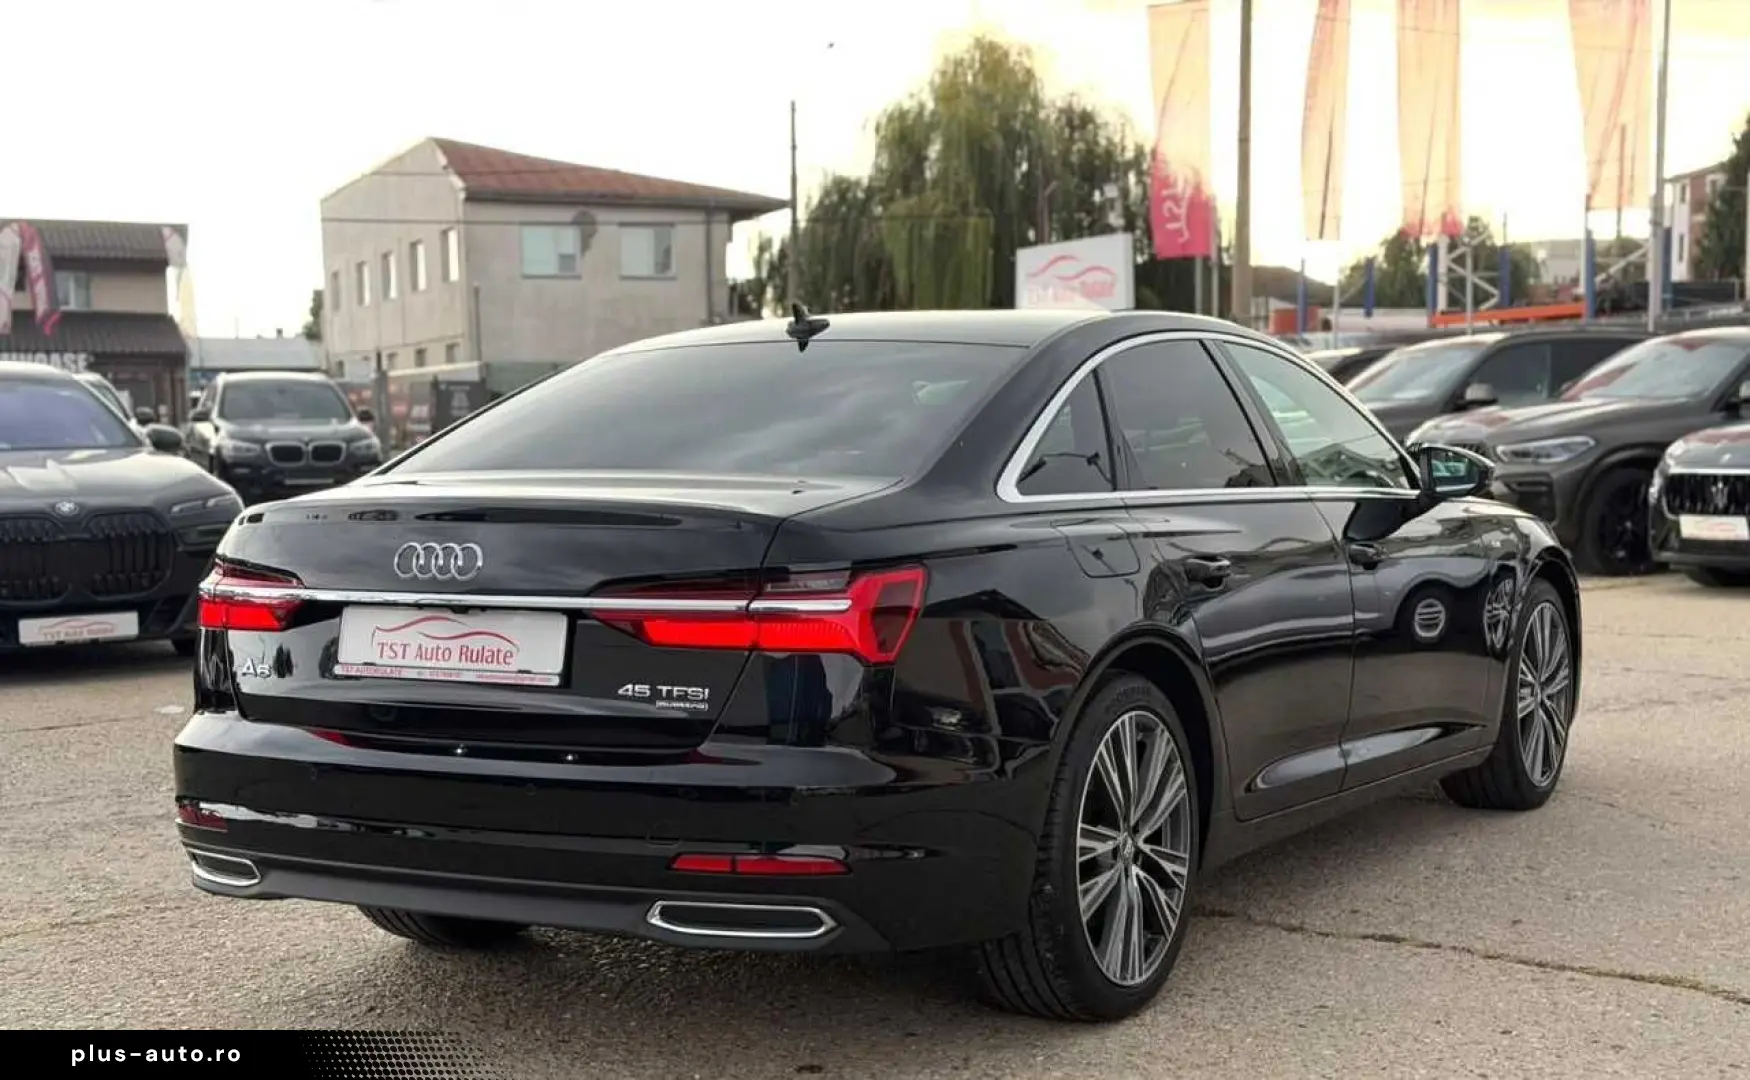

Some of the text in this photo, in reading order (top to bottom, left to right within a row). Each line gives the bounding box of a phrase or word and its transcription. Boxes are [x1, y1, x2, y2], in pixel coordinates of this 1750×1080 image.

[377, 641, 514, 666] TST Auto Rulate
[618, 684, 709, 700] 45 TFSI
